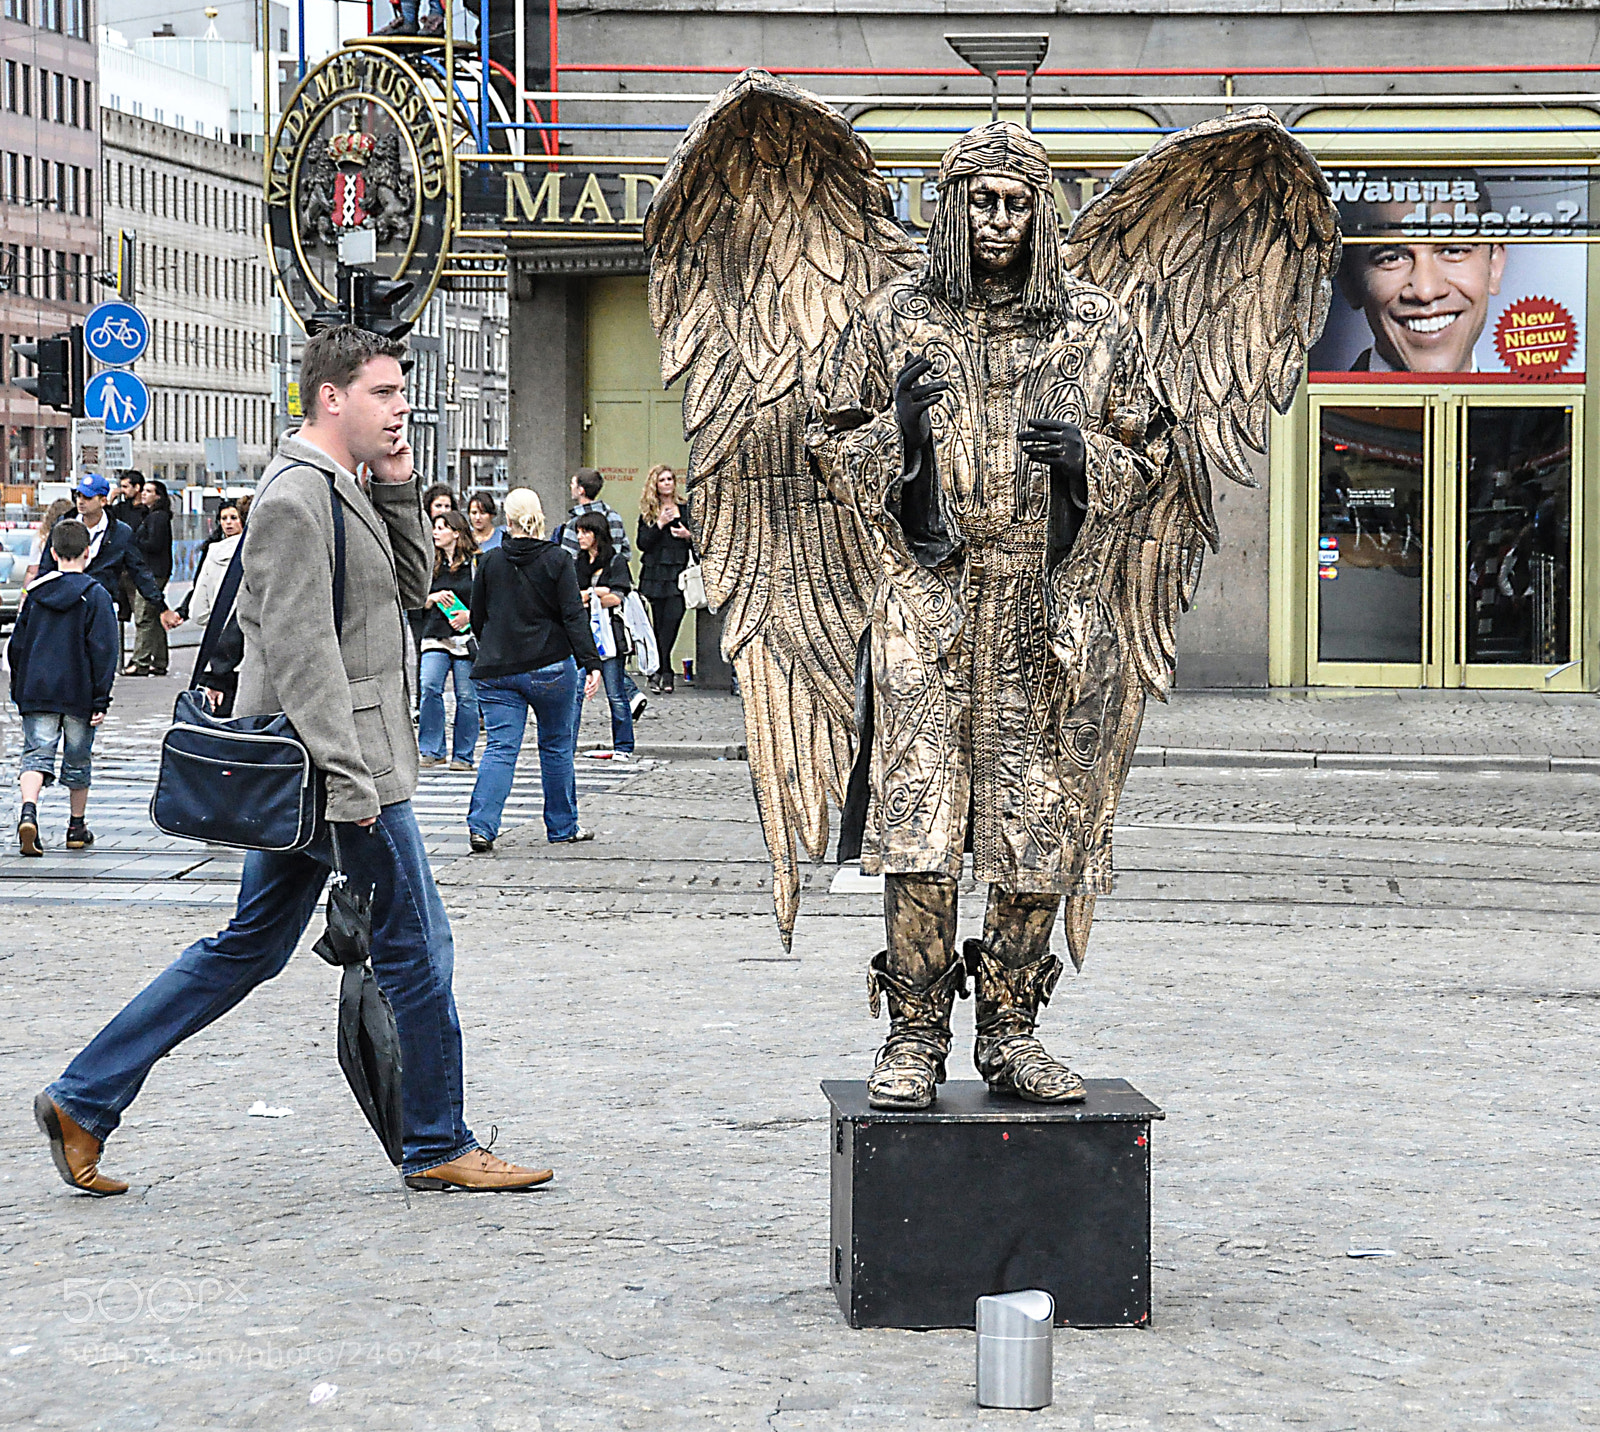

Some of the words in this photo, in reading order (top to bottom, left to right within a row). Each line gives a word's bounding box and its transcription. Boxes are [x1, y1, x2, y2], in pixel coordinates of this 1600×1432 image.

[270, 59, 359, 206] MADAME
[363, 57, 444, 200] TUSSAUD
[502, 172, 664, 224] MAD
[1324, 171, 1480, 202] wanna
[1401, 200, 1580, 236] debate?
[1511, 312, 1555, 328] New
[1504, 330, 1567, 348] Nieuw
[1516, 350, 1559, 366] New
